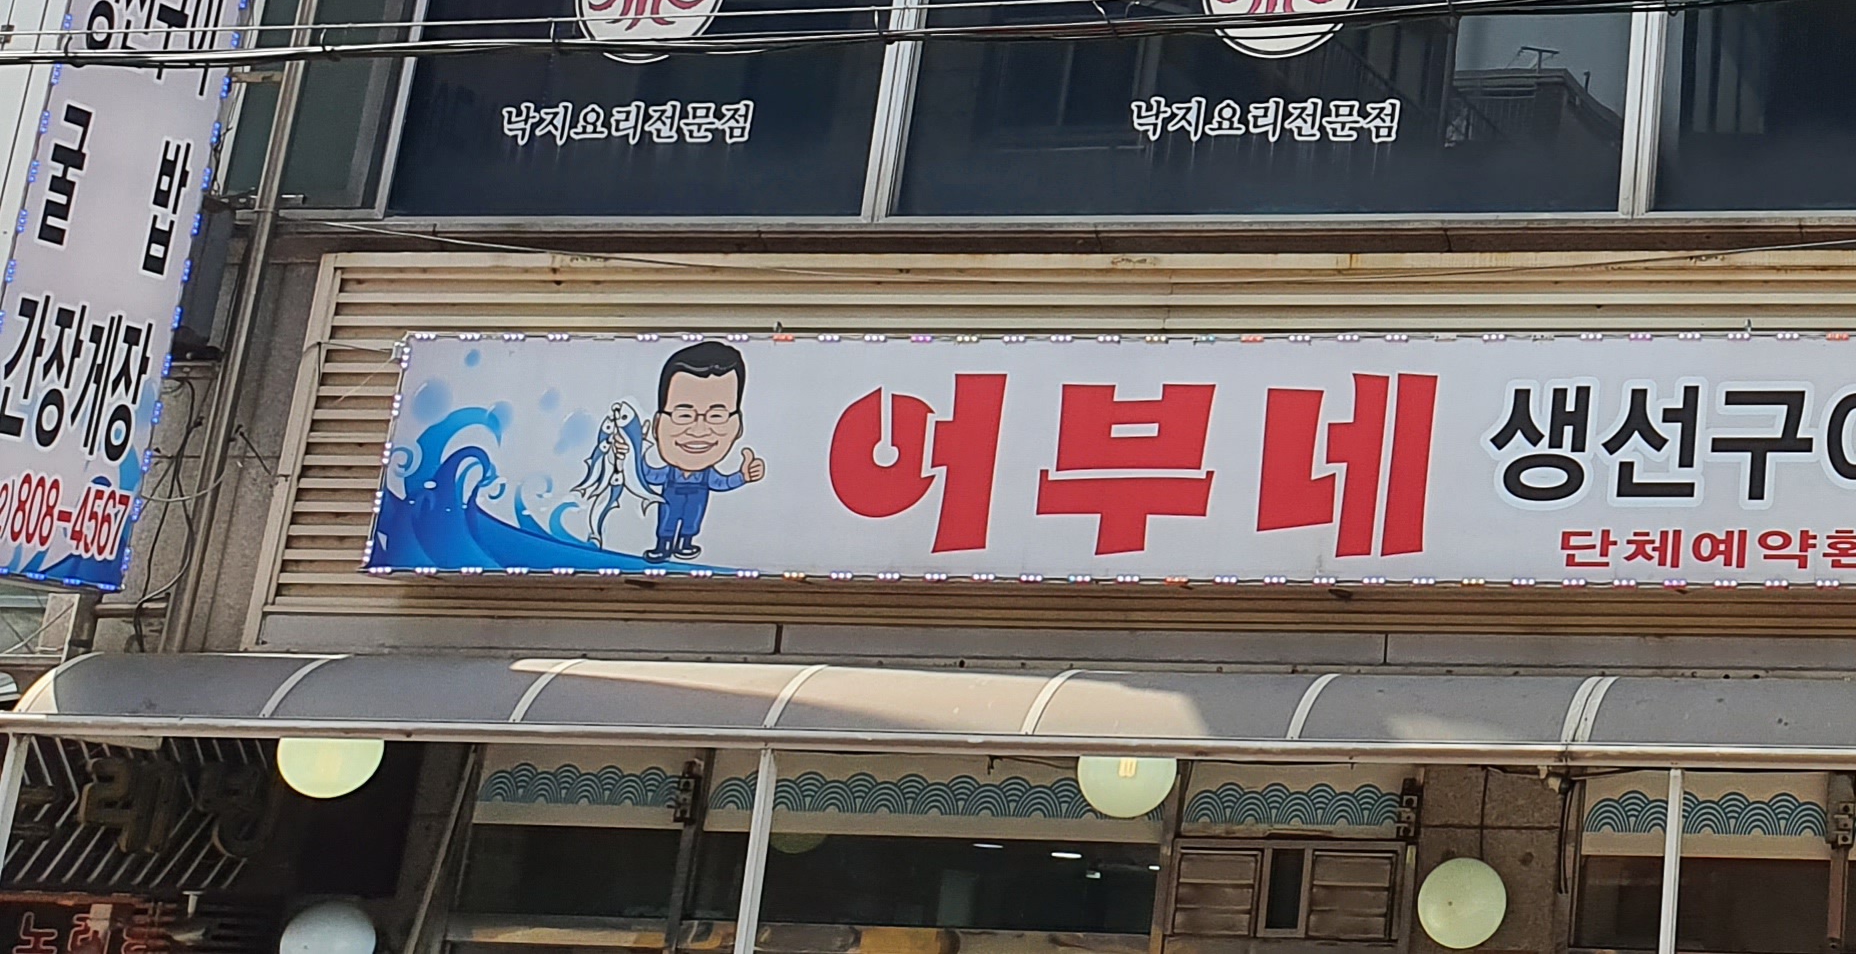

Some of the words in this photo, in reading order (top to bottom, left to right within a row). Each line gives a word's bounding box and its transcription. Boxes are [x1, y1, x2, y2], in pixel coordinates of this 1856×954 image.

[502, 99, 756, 146] 낙지요리전문점
[1130, 96, 1402, 144] 낙지요리전문점
[0, 295, 153, 461] 간장게장
[829, 372, 1439, 558] 어부네
